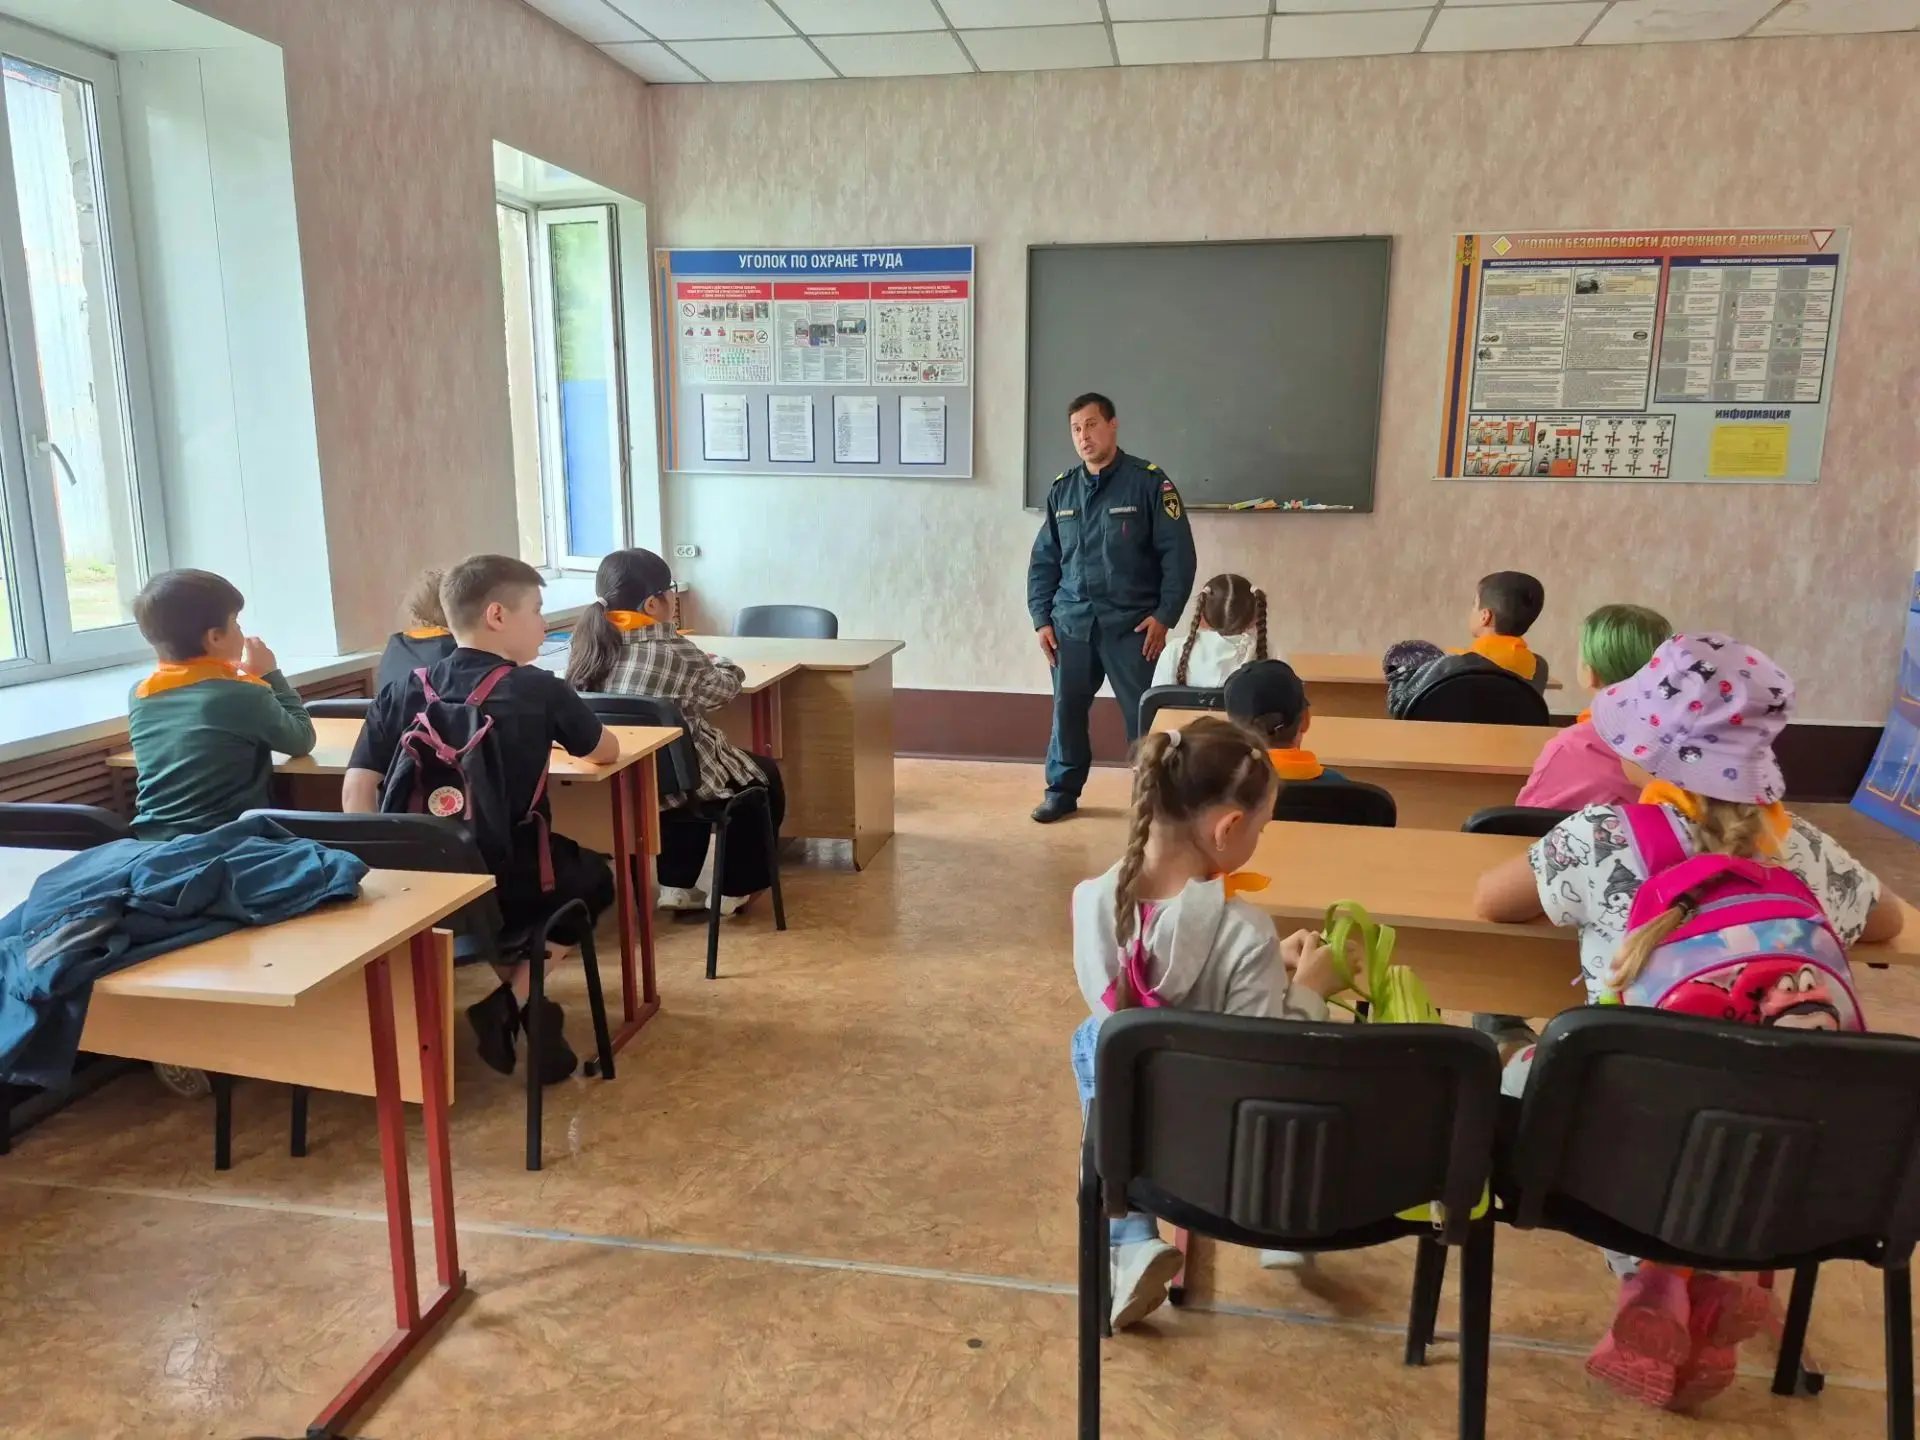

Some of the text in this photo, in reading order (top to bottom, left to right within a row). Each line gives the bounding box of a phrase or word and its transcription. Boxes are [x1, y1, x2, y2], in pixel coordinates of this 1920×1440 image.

[1564, 236, 1658, 249] БЕЗОПАСНОСТИ
[1660, 235, 1737, 248] ДОРОЖНОГО
[738, 253, 903, 269] УГОЛОК ПО ОХРАНЕ ТРУДА
[1714, 408, 1792, 420] информация
